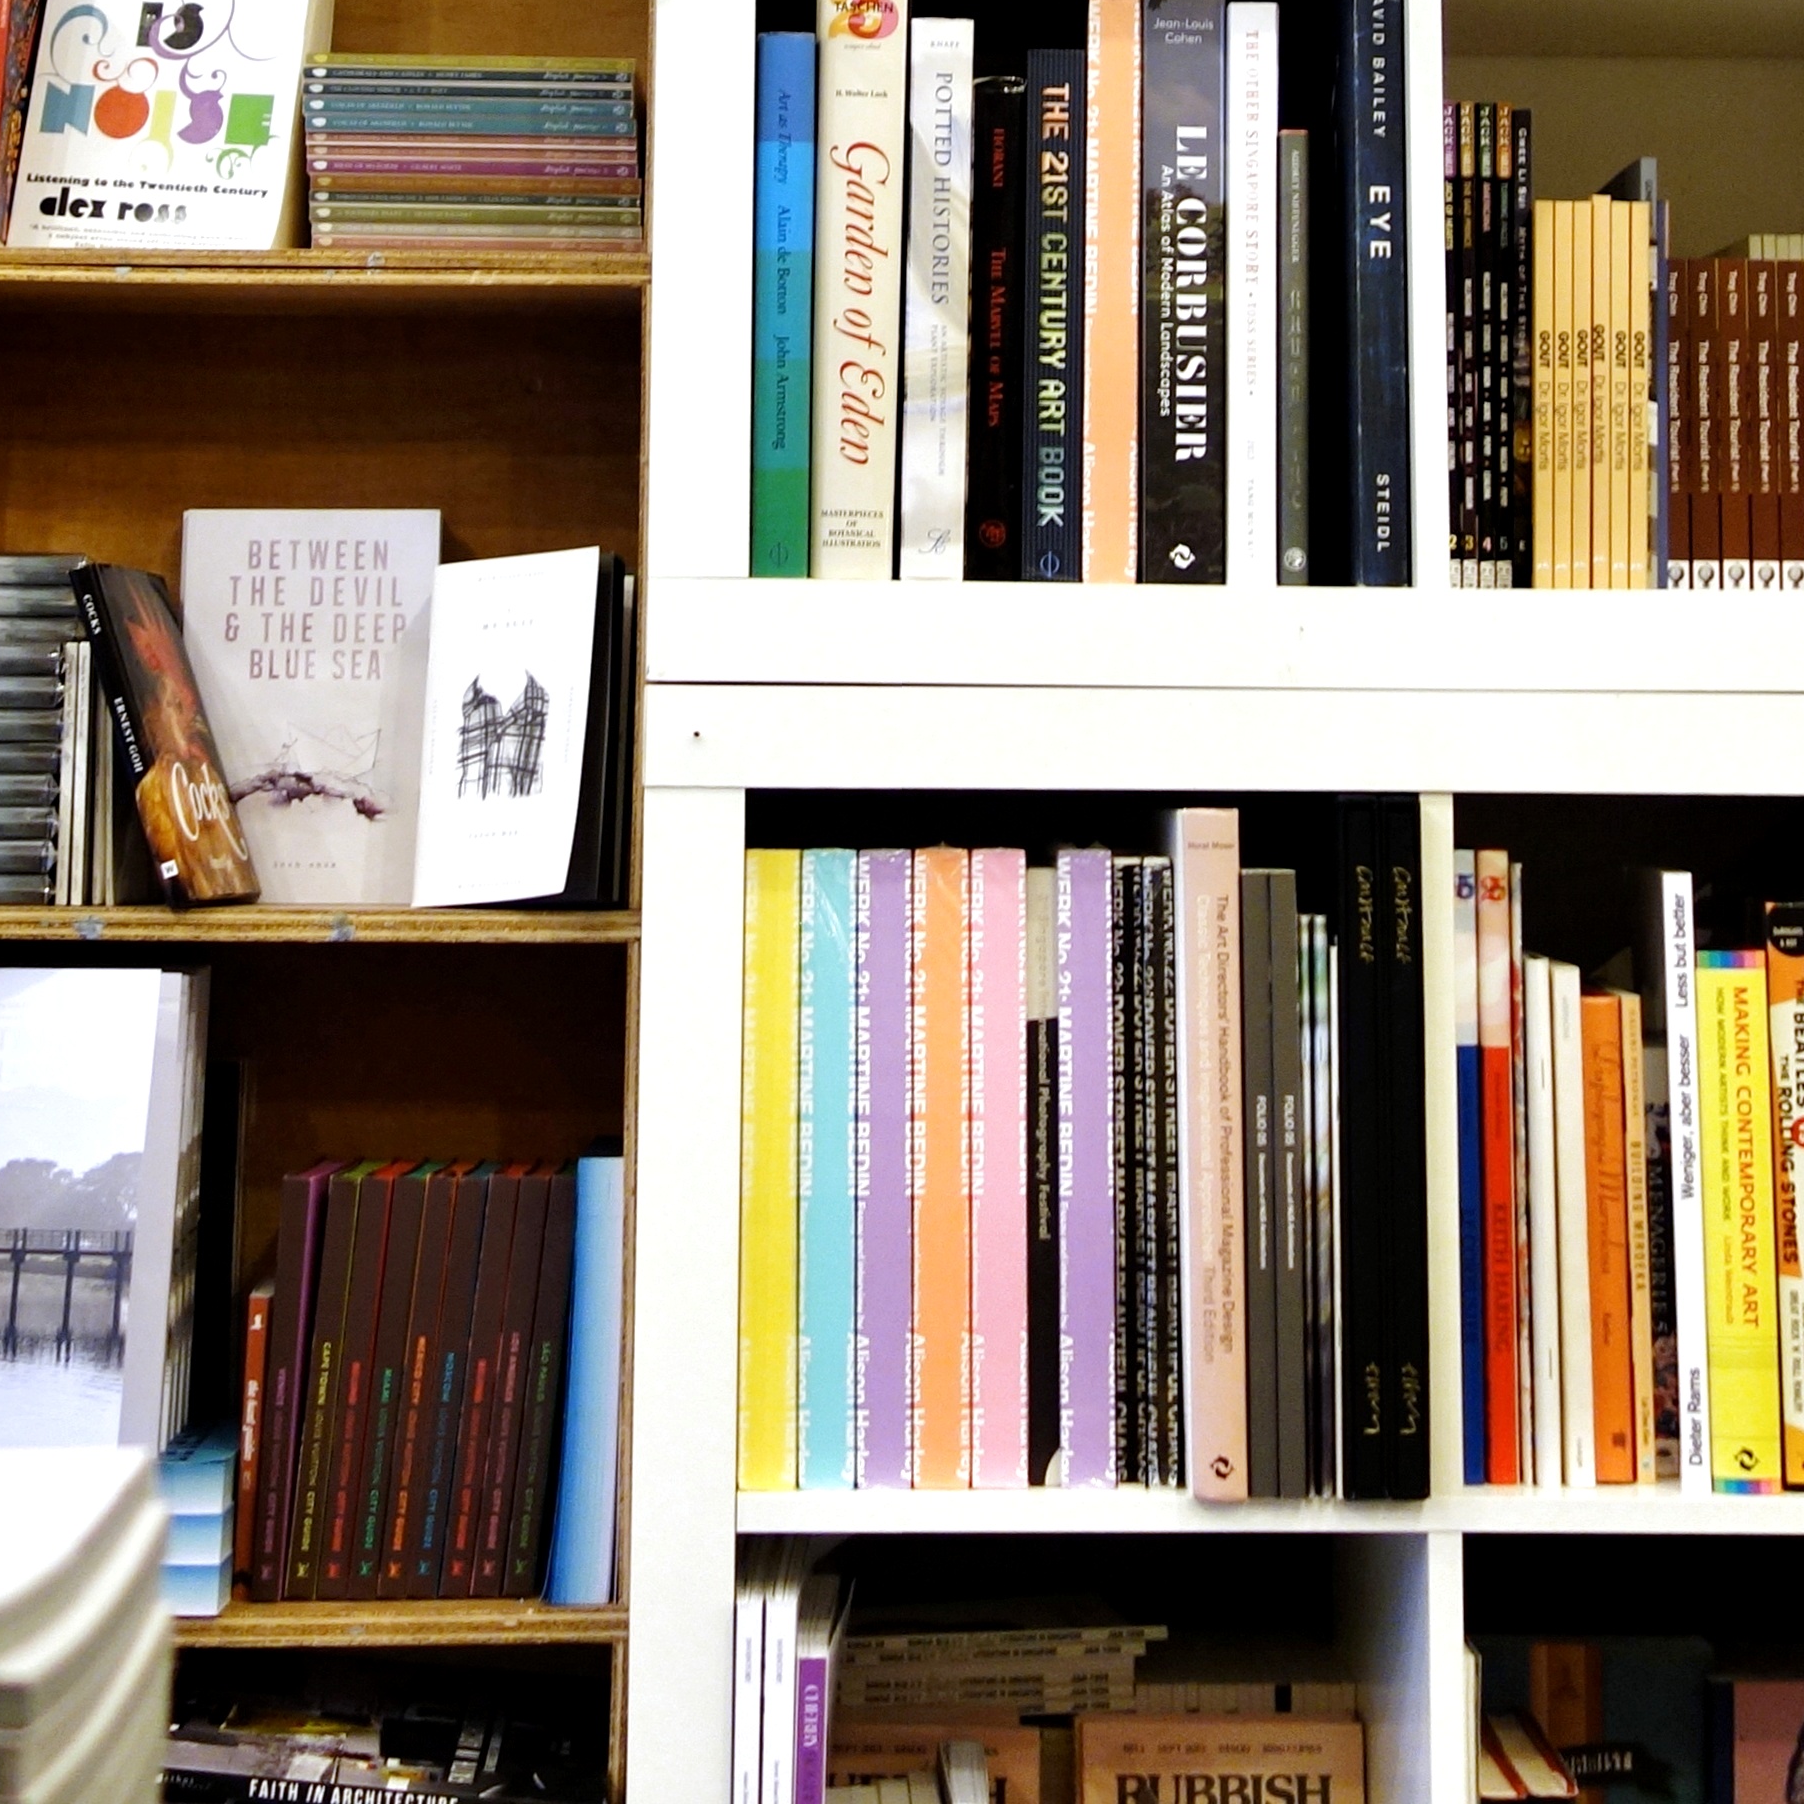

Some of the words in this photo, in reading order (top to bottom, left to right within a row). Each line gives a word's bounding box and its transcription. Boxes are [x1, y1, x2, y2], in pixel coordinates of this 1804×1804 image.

[138, 2, 204, 49] IS
[834, 1, 893, 13] TASCHEN
[1154, 17, 1214, 32] Jean-Louis
[1164, 31, 1202, 45] Cohen
[39, 81, 275, 146] NOISE
[933, 72, 953, 166] POTTED
[1041, 83, 1069, 139] THE
[1372, 57, 1385, 139] BAILEY
[1176, 125, 1207, 178] LE
[27, 171, 92, 186] Listening
[97, 175, 110, 188] to
[114, 176, 135, 189] the
[140, 178, 209, 194] Twentieth
[212, 183, 268, 198] Century
[39, 187, 104, 219] alex
[117, 200, 187, 223] ross
[1041, 151, 1068, 223] 21ST
[831, 141, 890, 296] Garden
[931, 177, 952, 304] HISTORIES
[1369, 184, 1391, 259] EYE
[1038, 232, 1068, 373] CENTURY
[834, 307, 886, 360] of
[1175, 197, 1207, 462] CORBUSIER
[839, 369, 885, 466] Eden
[1037, 381, 1066, 437] ART
[1036, 444, 1065, 528] BOOK
[1376, 474, 1390, 552] STEIDL
[248, 540, 389, 569] BETWEEN
[84, 594, 102, 634] COCKS
[229, 577, 292, 606] THE
[310, 577, 403, 607] DEVIL
[225, 613, 241, 641] &
[261, 613, 315, 642] THE
[324, 613, 406, 643] DEEP
[250, 649, 315, 679] BLUE
[332, 649, 381, 679] SEA
[114, 697, 134, 739] ERNEST
[129, 742, 144, 773] GOH
[170, 763, 245, 859] Cocks
[1671, 894, 1686, 939] better
[1673, 943, 1688, 968] but
[1673, 973, 1688, 1008] Less
[1733, 986, 1750, 1076] MAKING
[1775, 1087, 1794, 1177] ROLLING
[1736, 1086, 1755, 1273] CONTEMPORARY
[1779, 1183, 1797, 1262] STONES
[1743, 1283, 1758, 1326] ART
[1686, 1368, 1701, 1414] Rams
[1687, 1418, 1703, 1466] Dieter
[249, 1779, 297, 1801] FAITH
[306, 1783, 324, 1803] IN
[1117, 1774, 1332, 1804] RUBBISH
